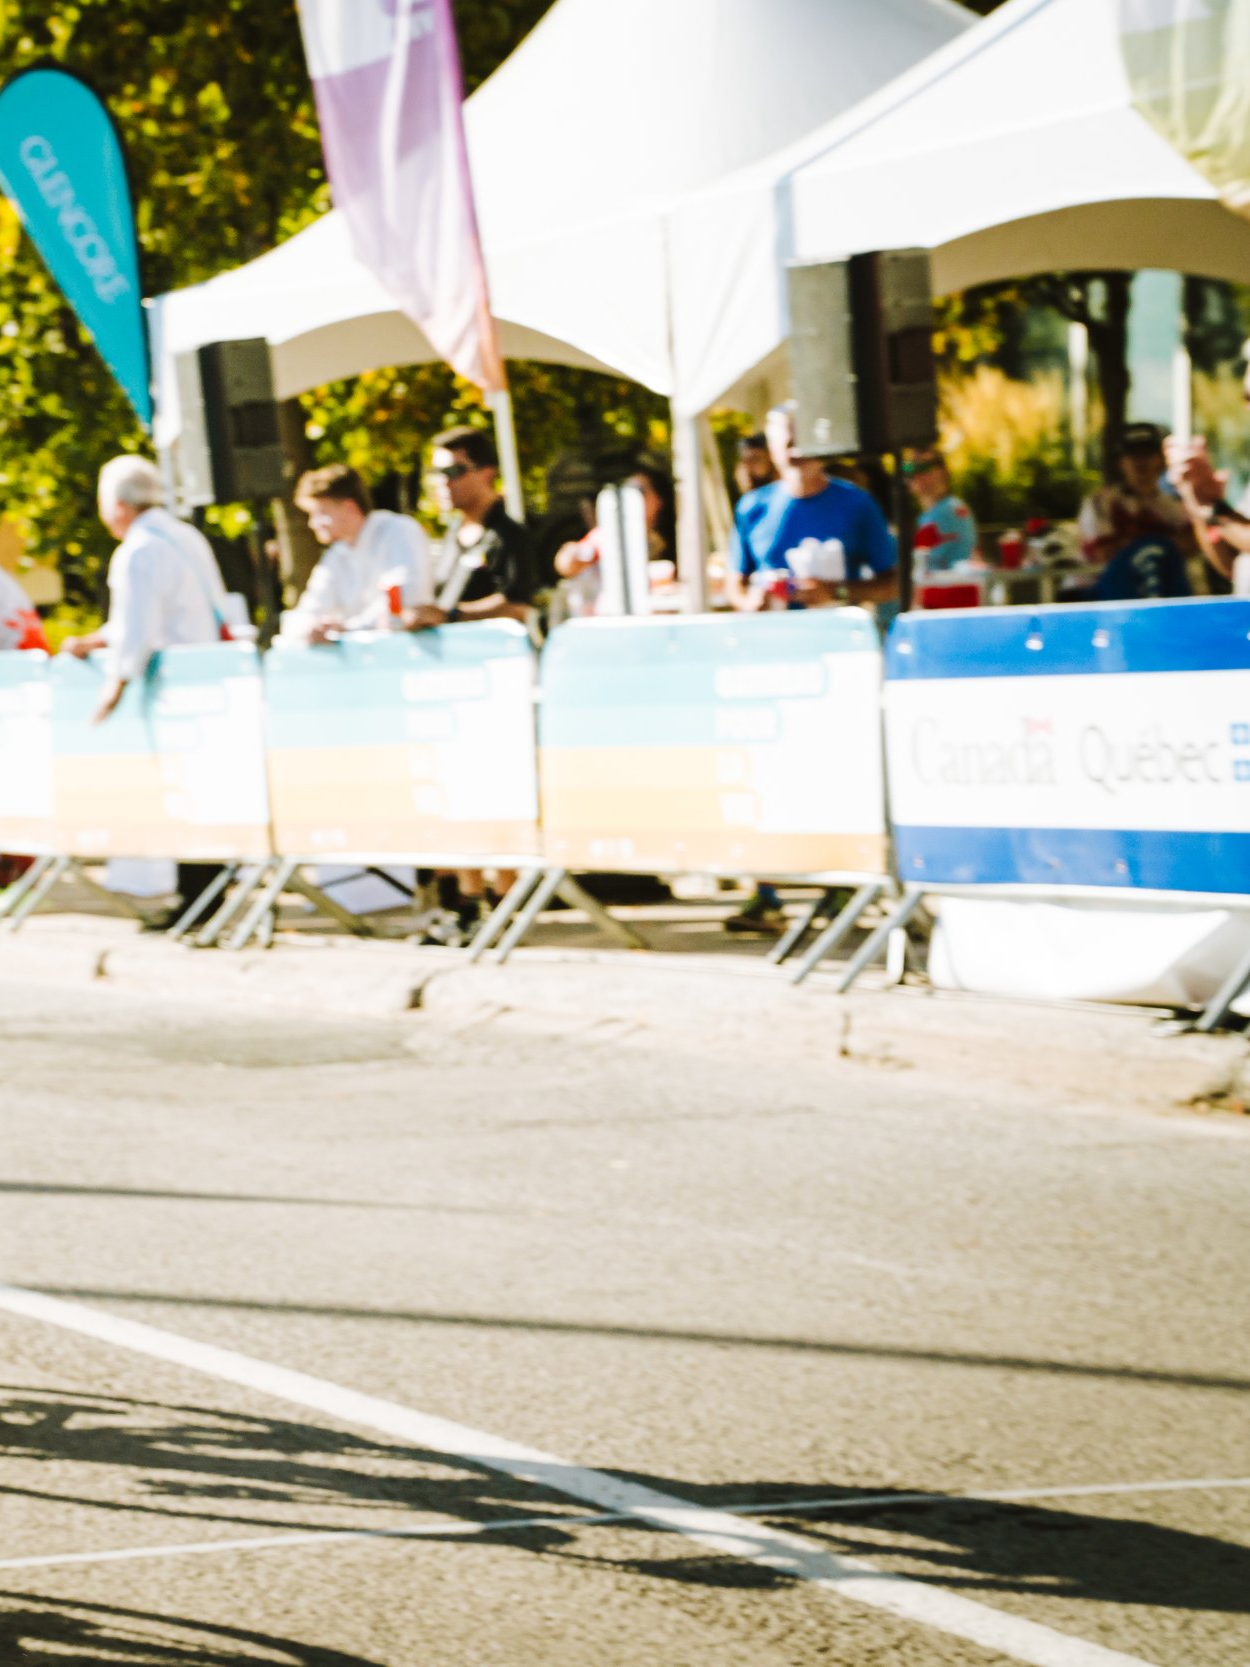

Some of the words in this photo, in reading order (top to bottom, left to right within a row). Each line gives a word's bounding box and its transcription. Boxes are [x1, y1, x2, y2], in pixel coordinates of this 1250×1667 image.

[19, 134, 131, 304] GLENCORE
[911, 715, 1058, 786] Canada
[1079, 722, 1224, 795] Québec
